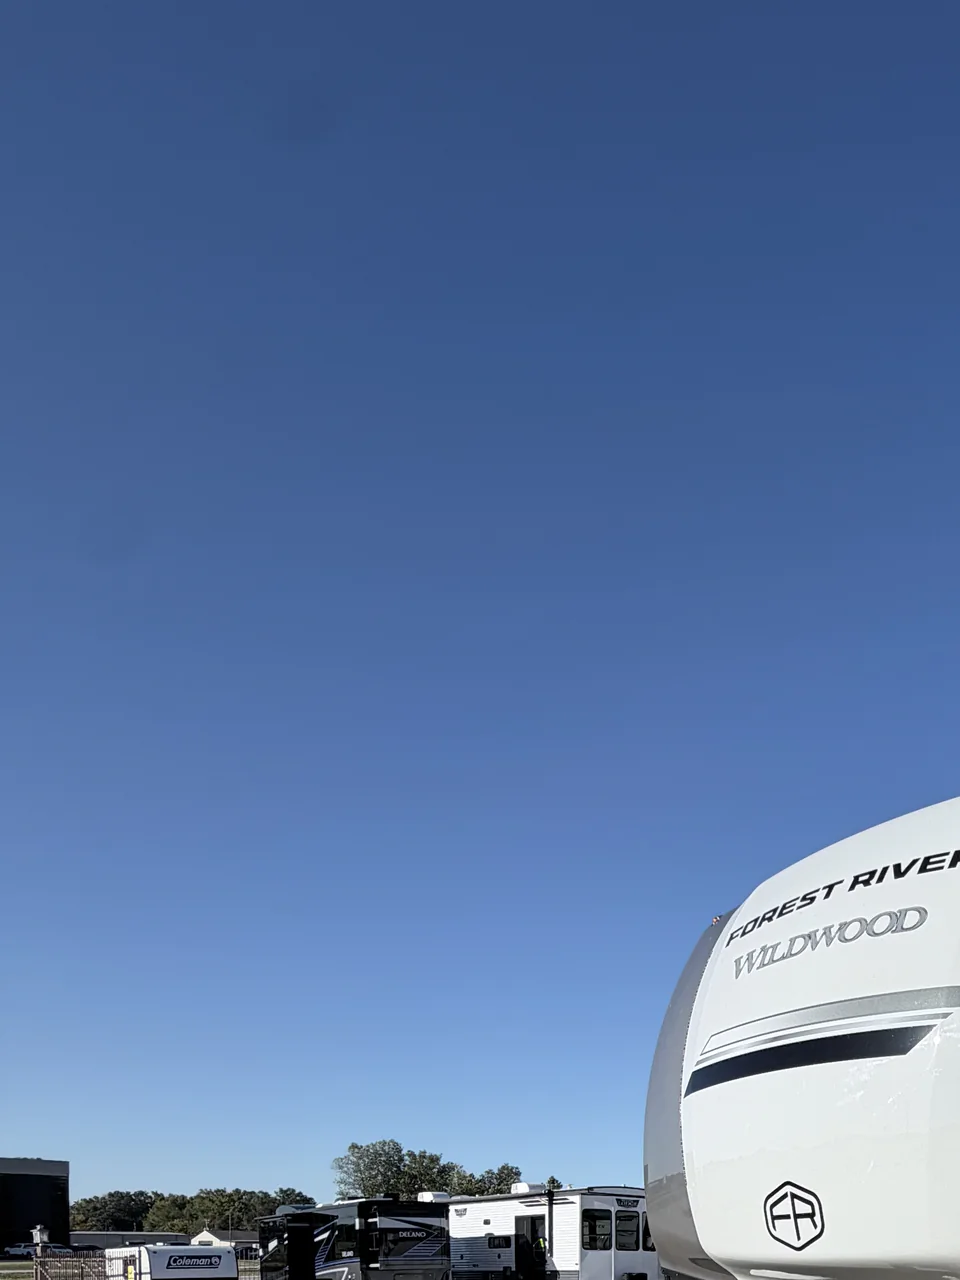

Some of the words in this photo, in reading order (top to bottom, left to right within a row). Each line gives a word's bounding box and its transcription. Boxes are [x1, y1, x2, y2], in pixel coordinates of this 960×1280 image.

[724, 879, 845, 949] FOREST
[733, 905, 930, 980] WILDWOOD
[169, 1255, 211, 1267] Coleman
